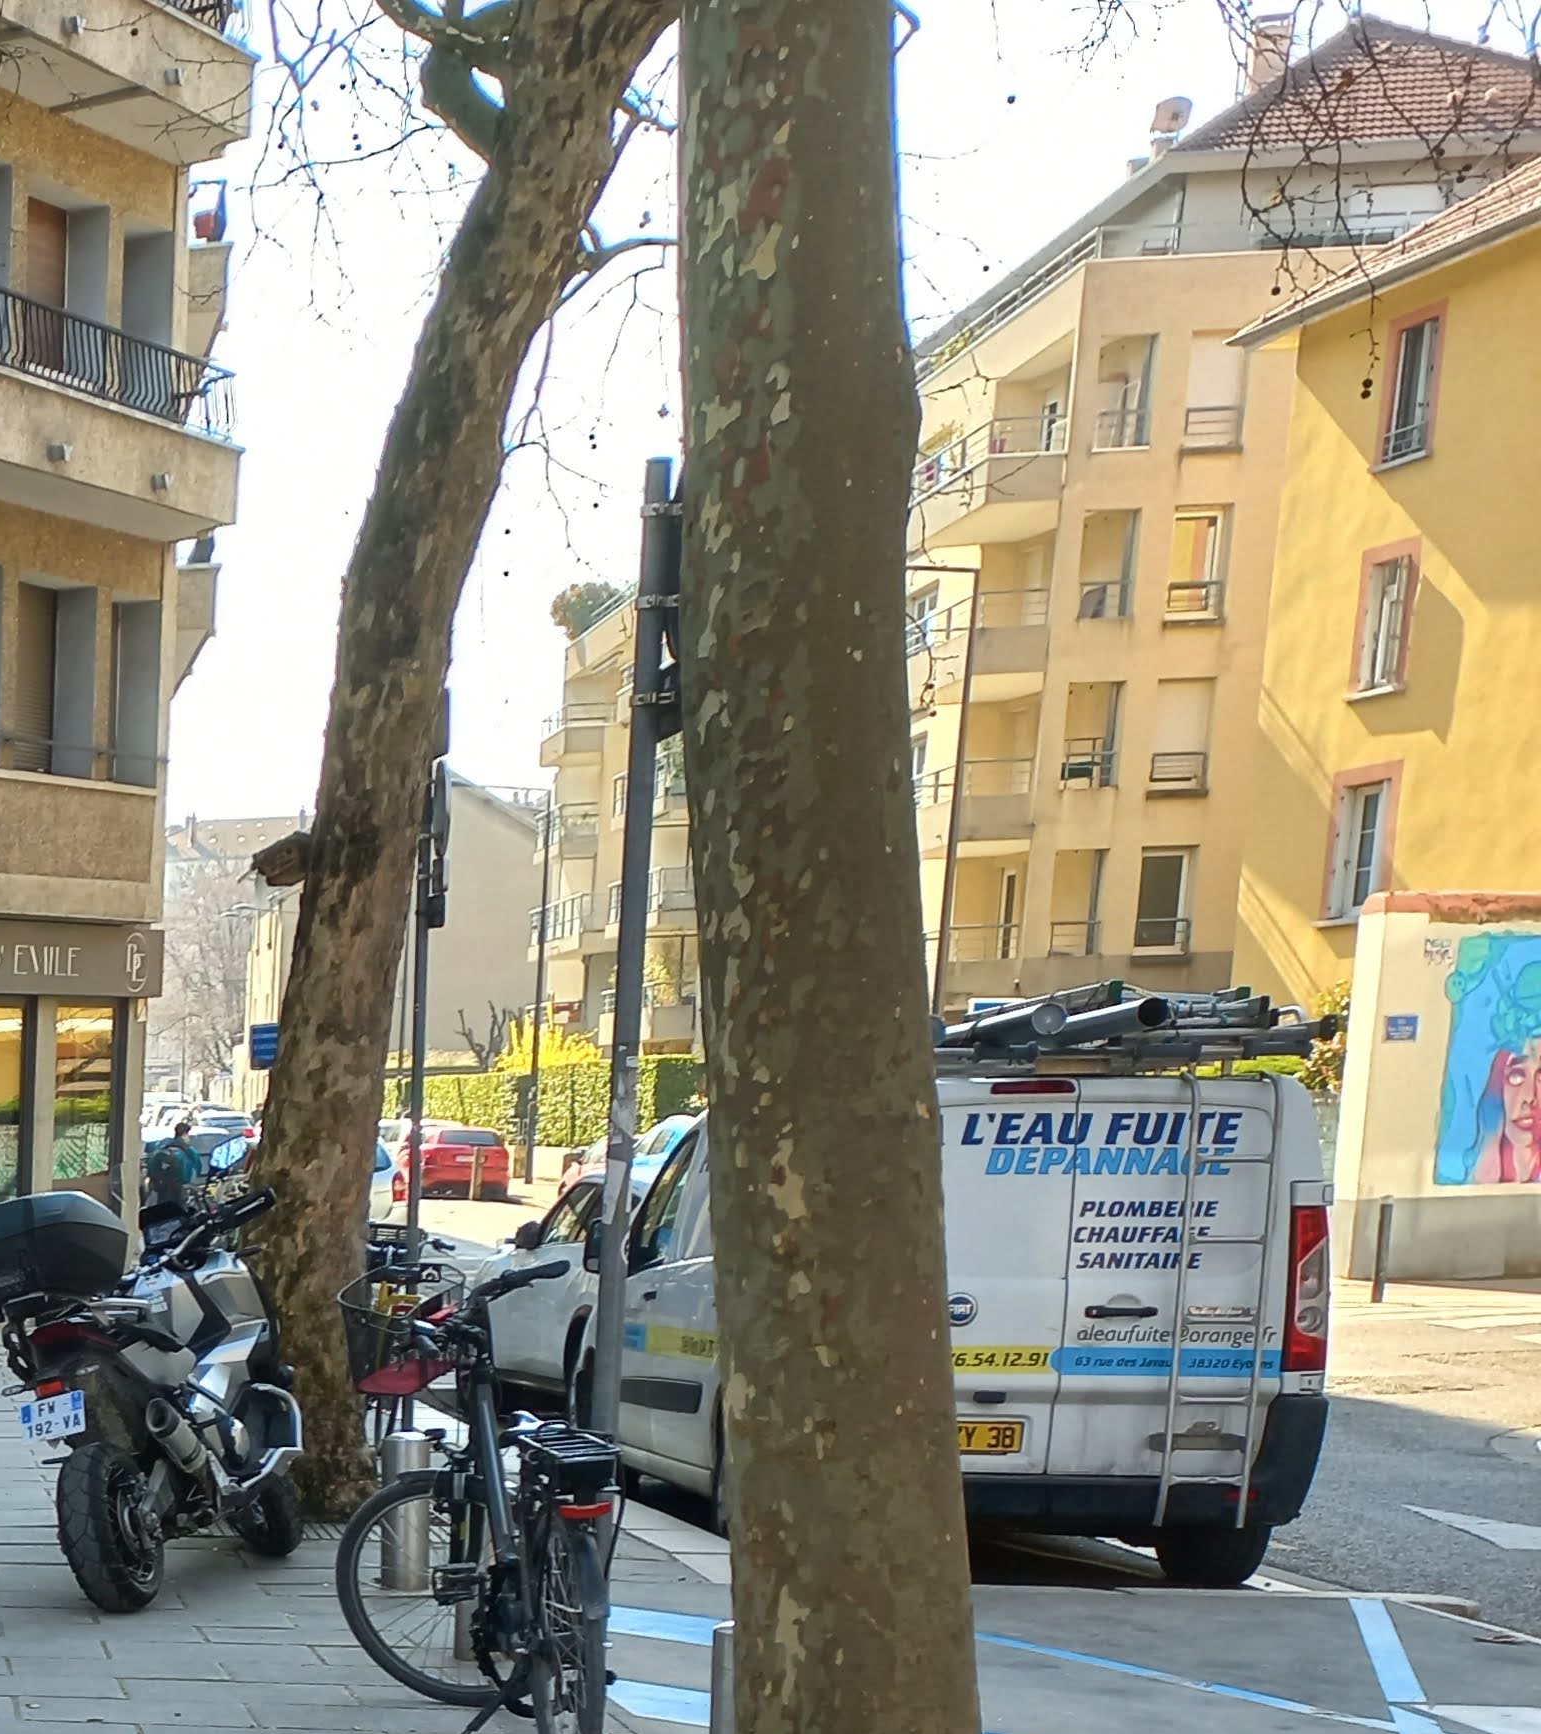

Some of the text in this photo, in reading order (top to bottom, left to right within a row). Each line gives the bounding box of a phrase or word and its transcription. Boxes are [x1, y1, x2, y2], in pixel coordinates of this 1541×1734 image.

[961, 1112, 1094, 1146] L'EAU
[1105, 1111, 1244, 1146] FUITE
[985, 1147, 1235, 1176] DEPANNAGE
[1077, 1324, 1277, 1349] aleaufuite@orangefr
[951, 1352, 1049, 1367] 6.54.12.91
[1093, 1359, 1114, 1367] rue
[1116, 1357, 1137, 1367] des
[1231, 1359, 1274, 1370] Eybns
[986, 1427, 1016, 1449] 38
